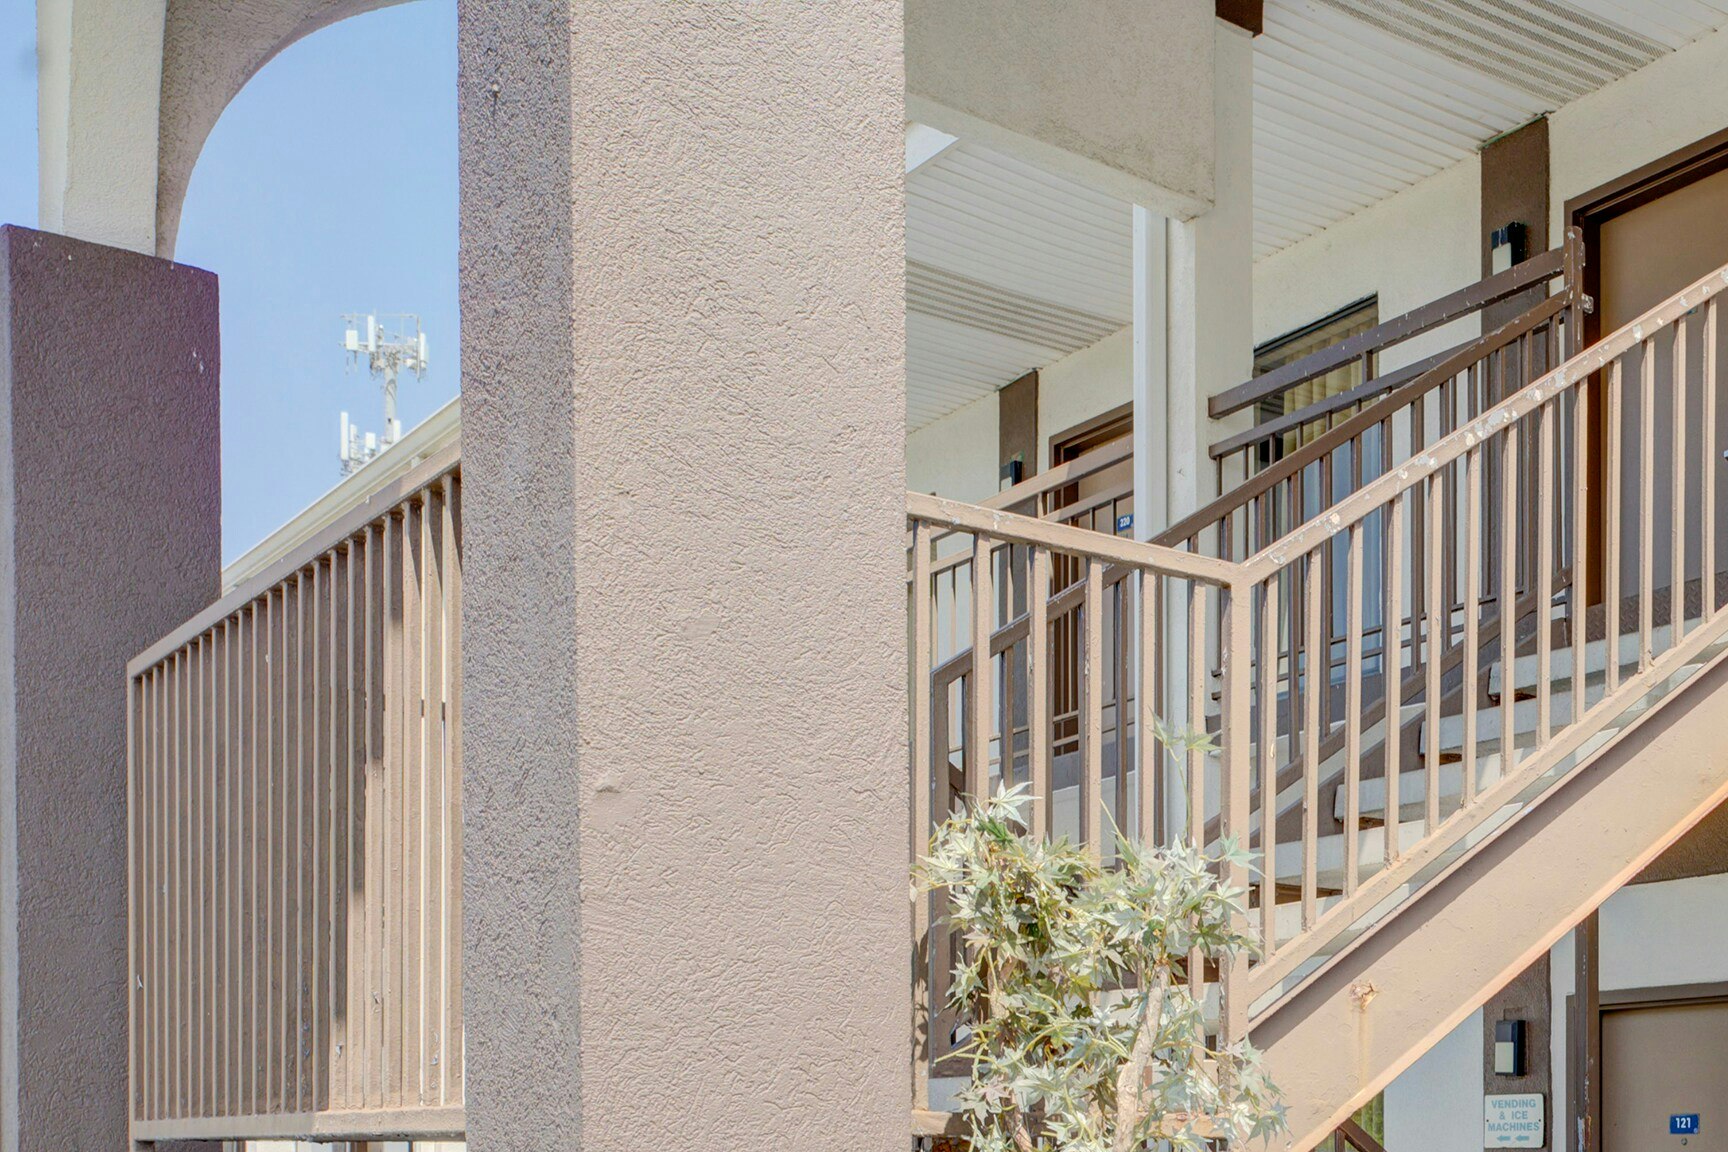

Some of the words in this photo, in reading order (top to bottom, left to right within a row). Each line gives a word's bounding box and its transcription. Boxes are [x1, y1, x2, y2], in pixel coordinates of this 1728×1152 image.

[1491, 1099, 1537, 1109] VENDING
[1498, 1111, 1506, 1120] &
[1511, 1110, 1528, 1120] ICE
[1487, 1121, 1540, 1132] MACHINES
[1675, 1117, 1691, 1129] 121
